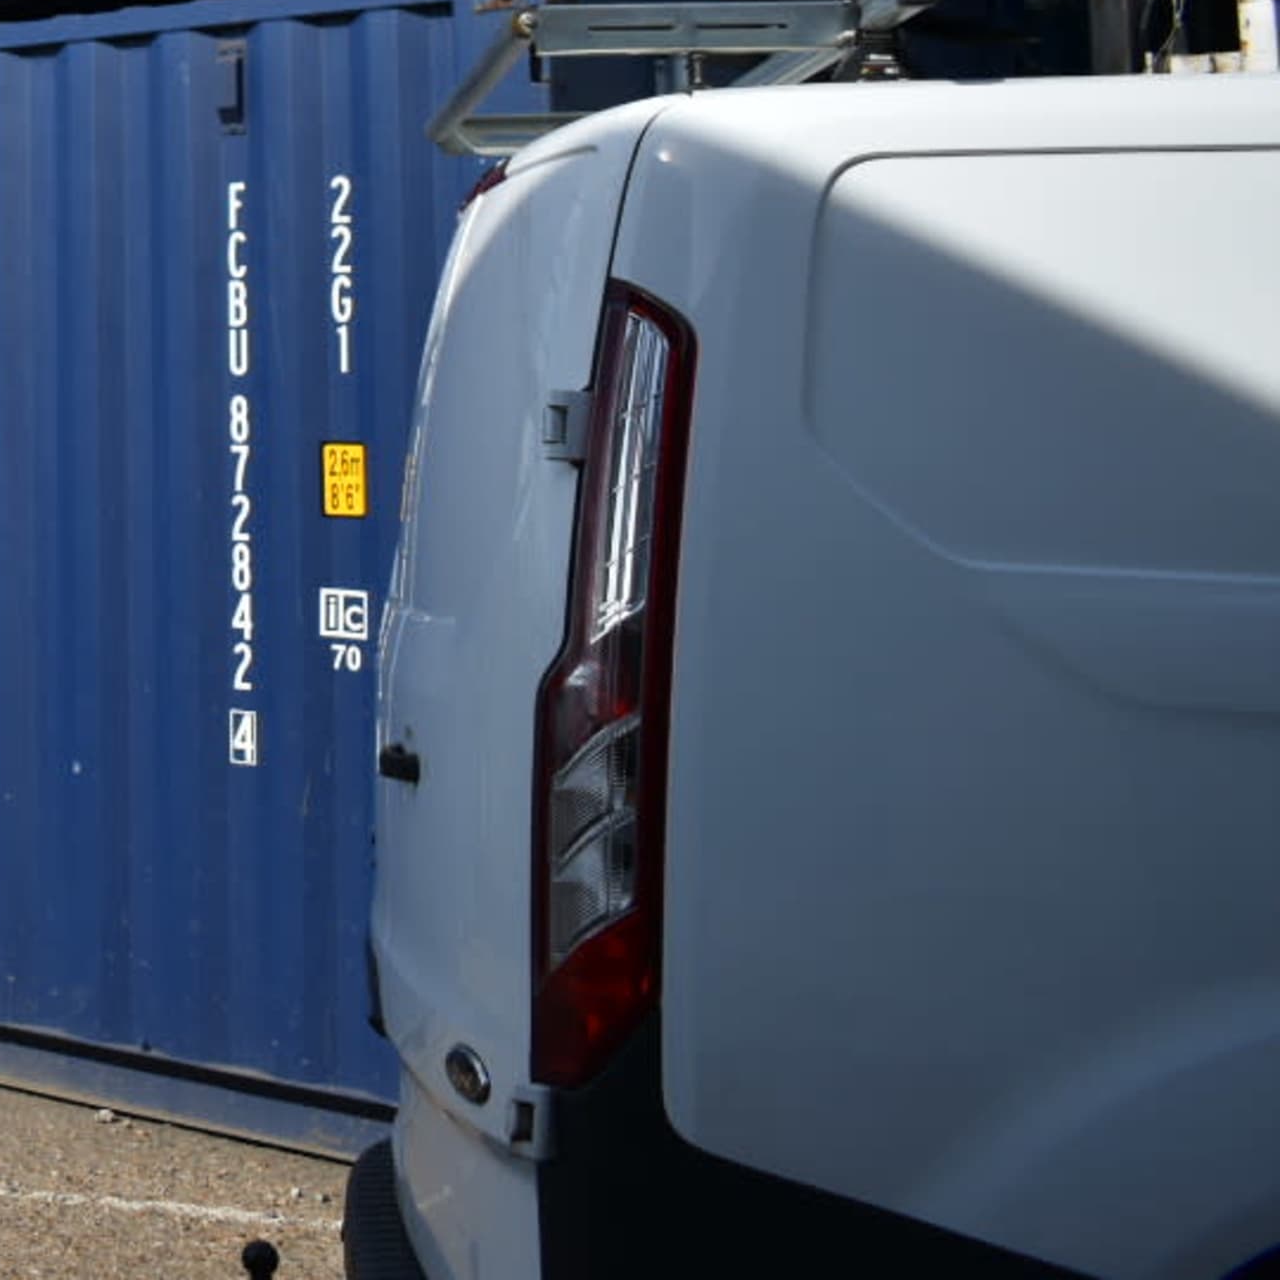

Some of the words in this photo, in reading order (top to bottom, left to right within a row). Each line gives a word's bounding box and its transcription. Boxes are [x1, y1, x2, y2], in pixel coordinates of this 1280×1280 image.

[228, 181, 249, 376] FCBU
[330, 175, 353, 373] 22G1
[229, 395, 253, 691] 872842
[232, 710, 256, 763] 4
[330, 643, 362, 672] 70
